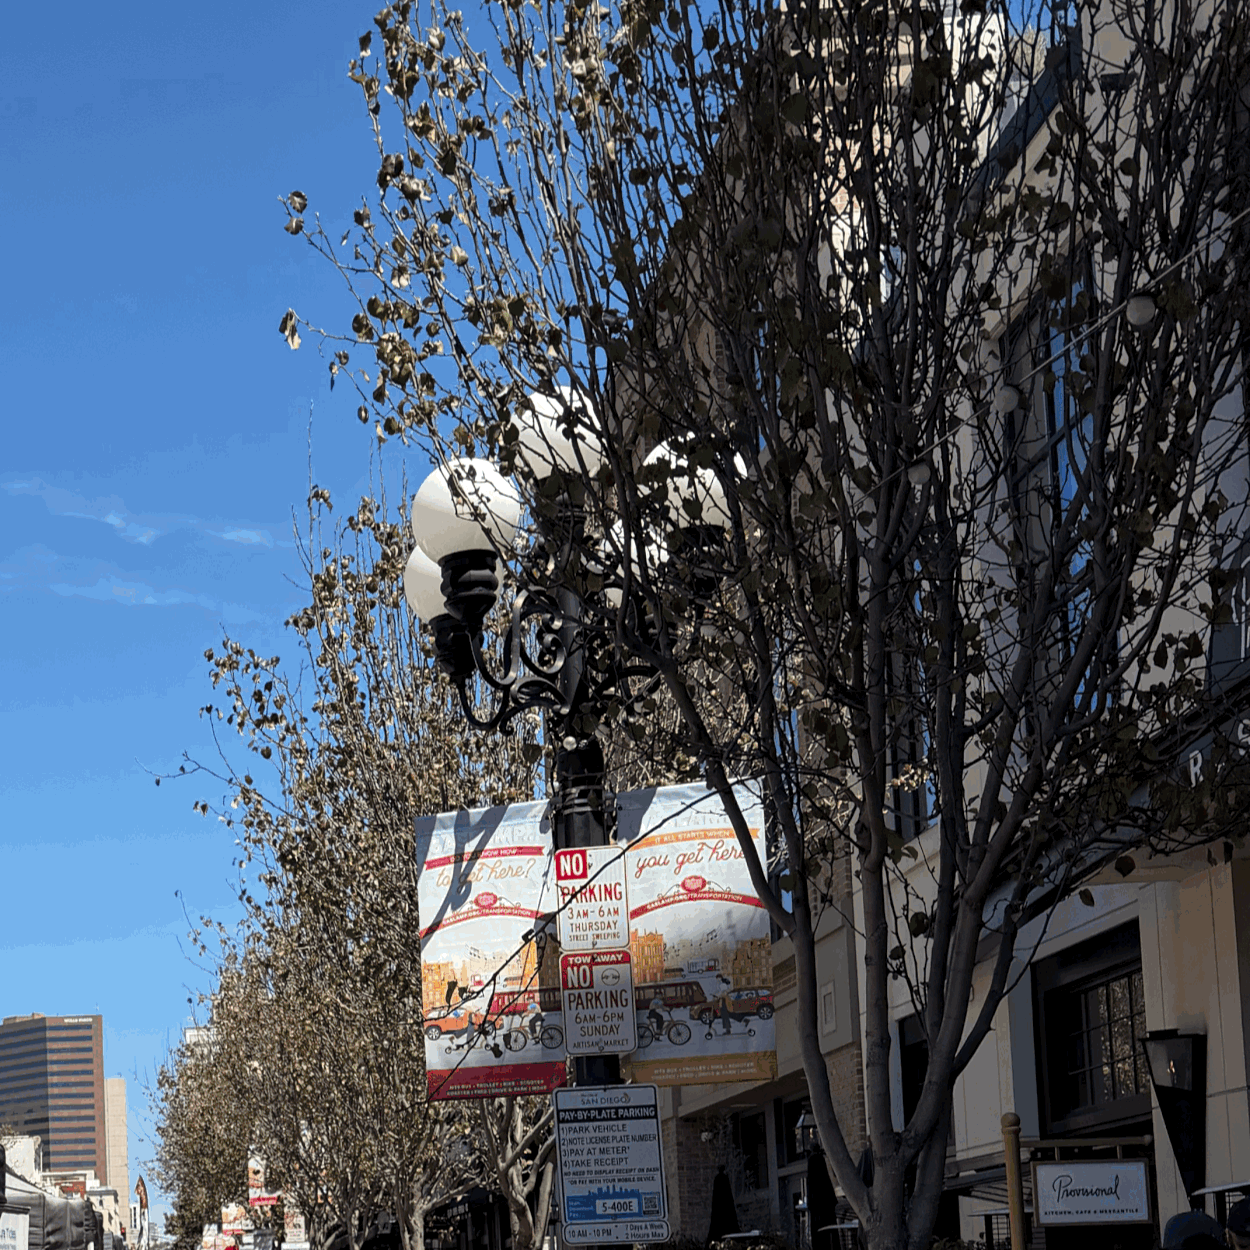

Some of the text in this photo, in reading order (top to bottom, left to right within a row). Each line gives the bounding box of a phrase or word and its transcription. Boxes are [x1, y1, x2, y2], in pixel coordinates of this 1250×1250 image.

[560, 853, 583, 877] NO
[634, 854, 670, 879] you
[673, 842, 703, 875] get
[486, 858, 537, 882] here?
[560, 882, 623, 904] PARKING
[570, 920, 618, 933] THURSDAY
[569, 931, 620, 942] STREET SWEEPING
[567, 965, 591, 988] NO
[568, 989, 628, 1011] PARKING
[580, 1024, 621, 1037] SUNDAY
[573, 1038, 629, 1049] ARTISAN MARKET
[600, 1095, 628, 1104] DIEGO
[618, 1107, 655, 1118] PARKING
[592, 1123, 627, 1133] VEHICLE
[586, 1135, 610, 1145] LICENSE
[611, 1134, 630, 1143] PLATE
[631, 1133, 657, 1142] NUMBER
[586, 1147, 596, 1156] AT
[594, 1157, 629, 1167] RECEIPT
[1052, 1173, 1121, 1203] Provisional
[602, 1201, 634, 1212] 5-400E
[568, 1230, 575, 1238] 10
[577, 1230, 587, 1238] AM
[593, 1229, 601, 1237] 10
[602, 1229, 612, 1237] PM
[629, 1224, 643, 1232] Days
